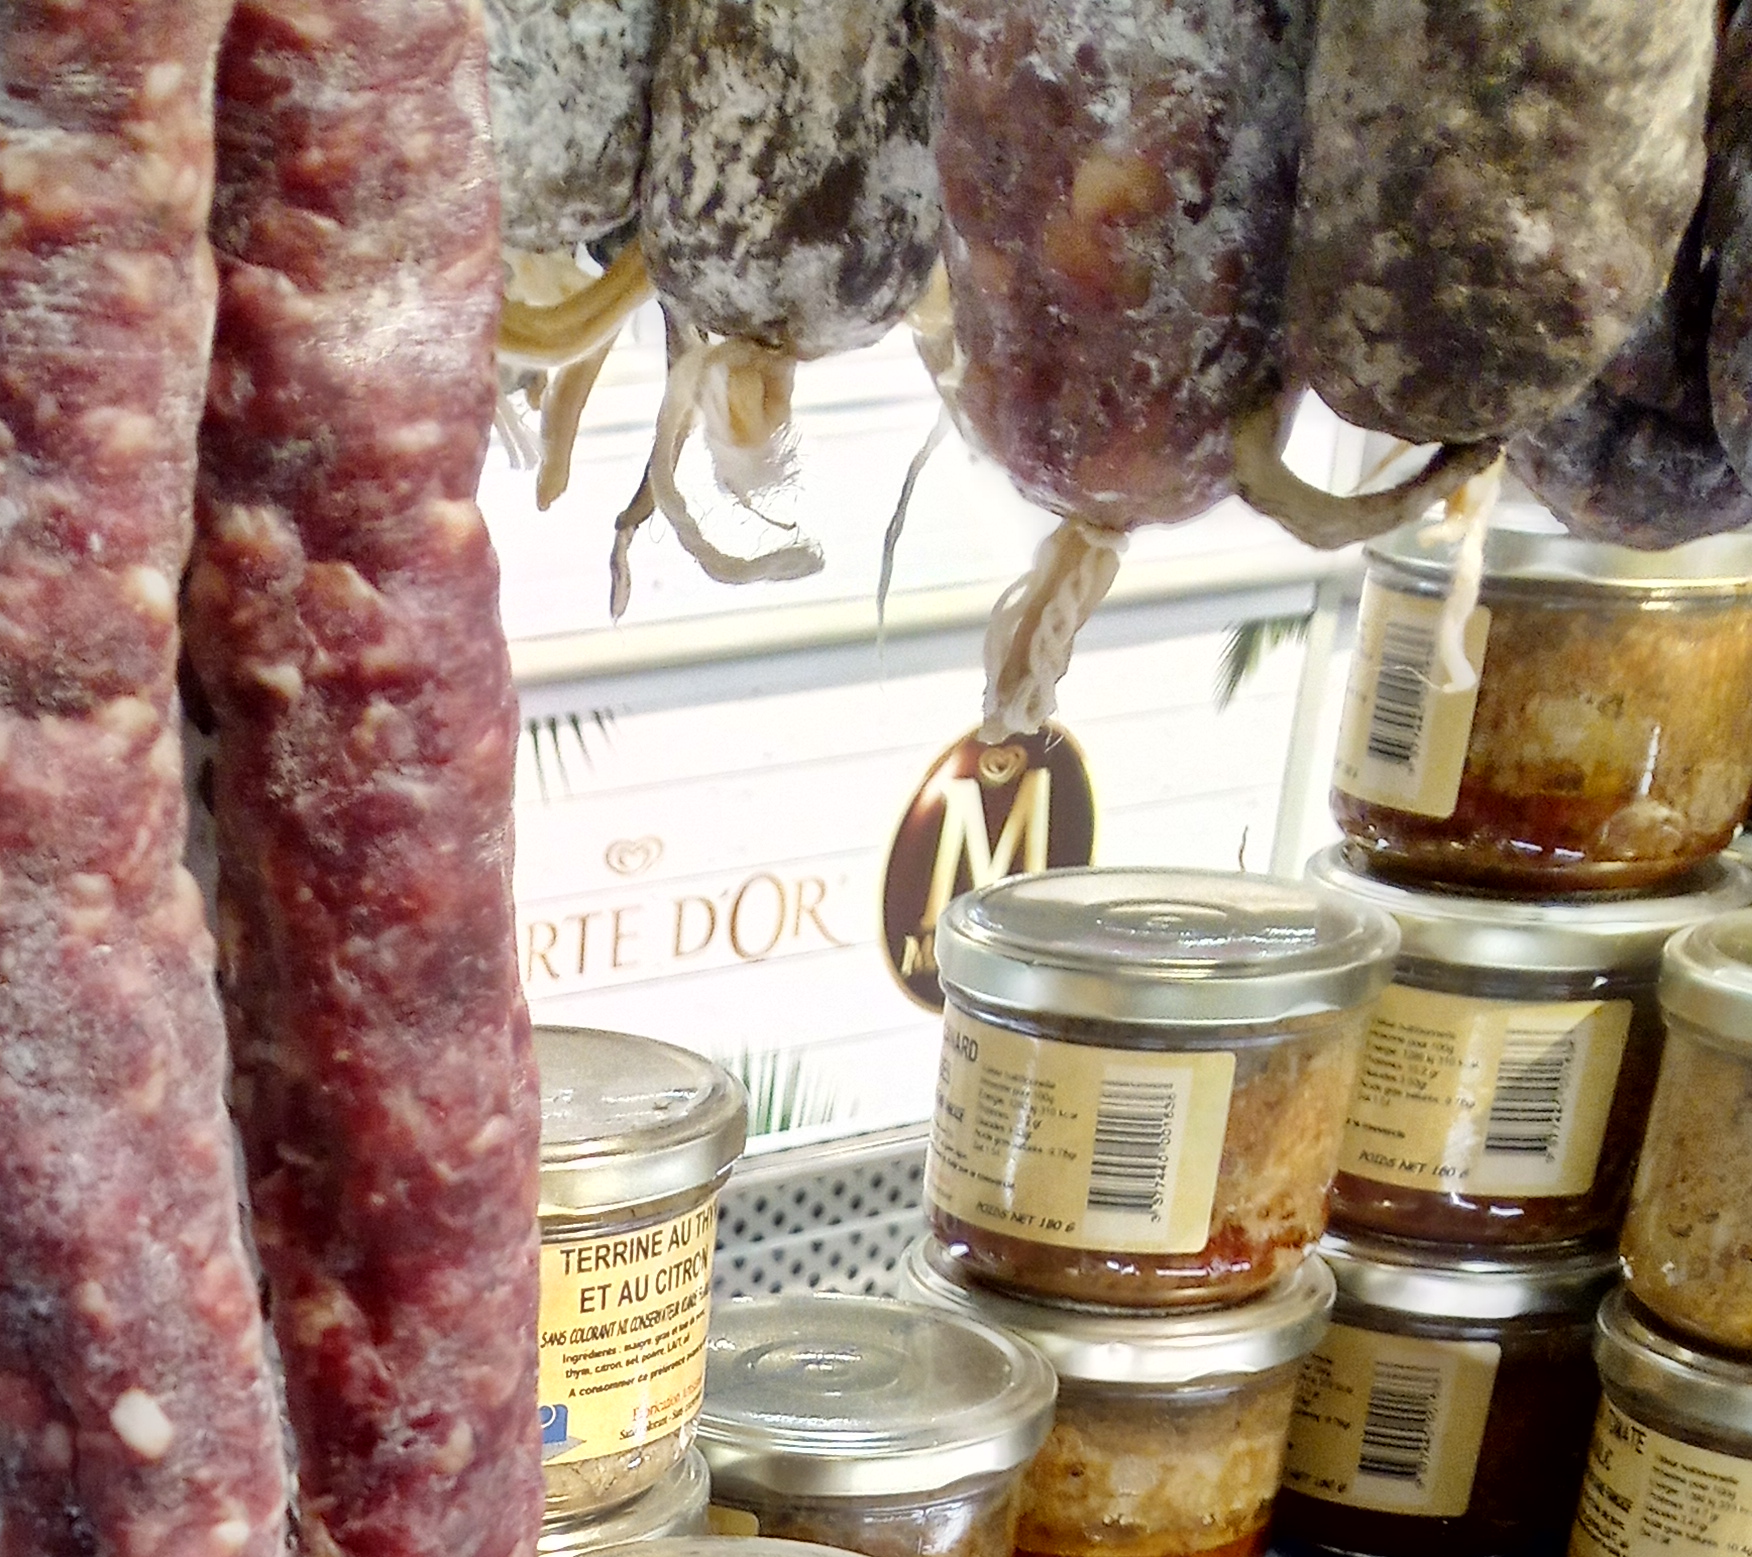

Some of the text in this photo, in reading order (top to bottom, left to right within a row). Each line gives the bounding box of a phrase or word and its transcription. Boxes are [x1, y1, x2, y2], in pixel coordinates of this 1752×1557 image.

[528, 907, 642, 982] RTE
[560, 1226, 691, 1275] TERRINE AU
[580, 1245, 710, 1314] ET AU CITRON
[570, 1322, 616, 1345] COLORANT
